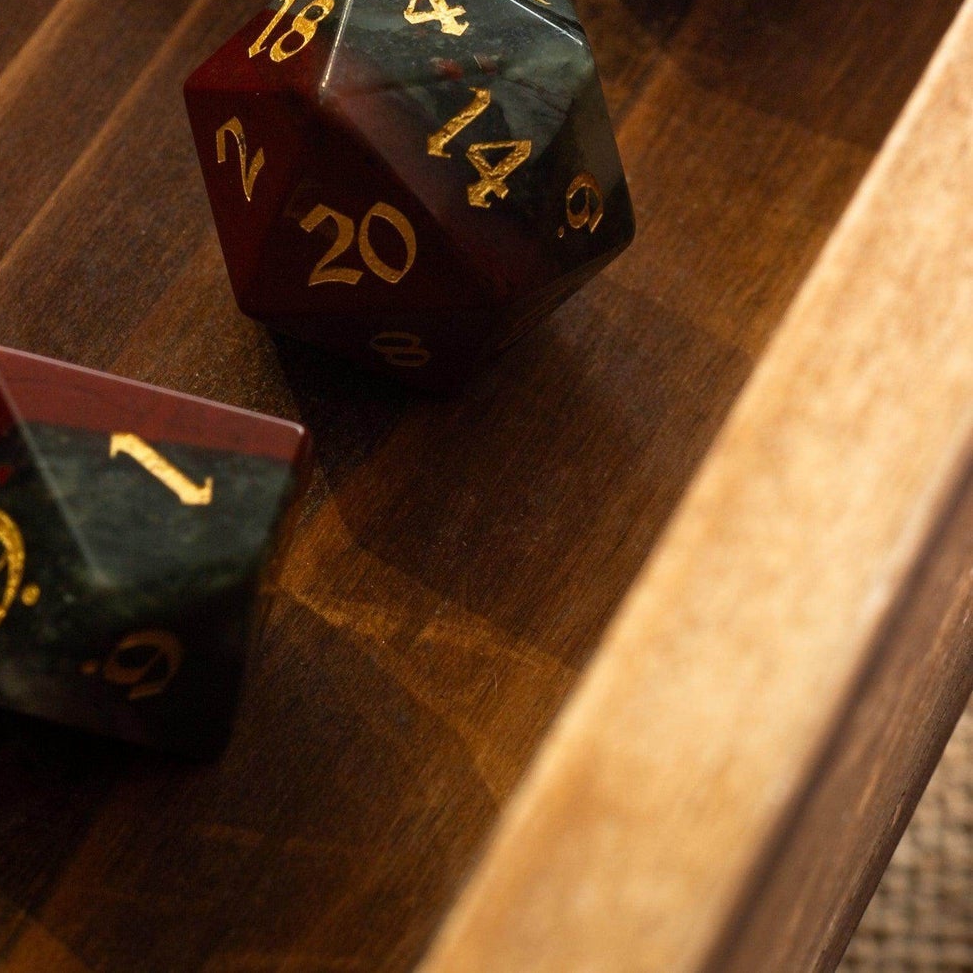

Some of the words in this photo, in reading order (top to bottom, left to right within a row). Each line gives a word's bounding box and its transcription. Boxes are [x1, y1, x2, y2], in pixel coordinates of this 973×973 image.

[216, 116, 265, 202] 2
[427, 86, 532, 209] 14
[300, 201, 417, 287] 20
[109, 432, 214, 506] 1
